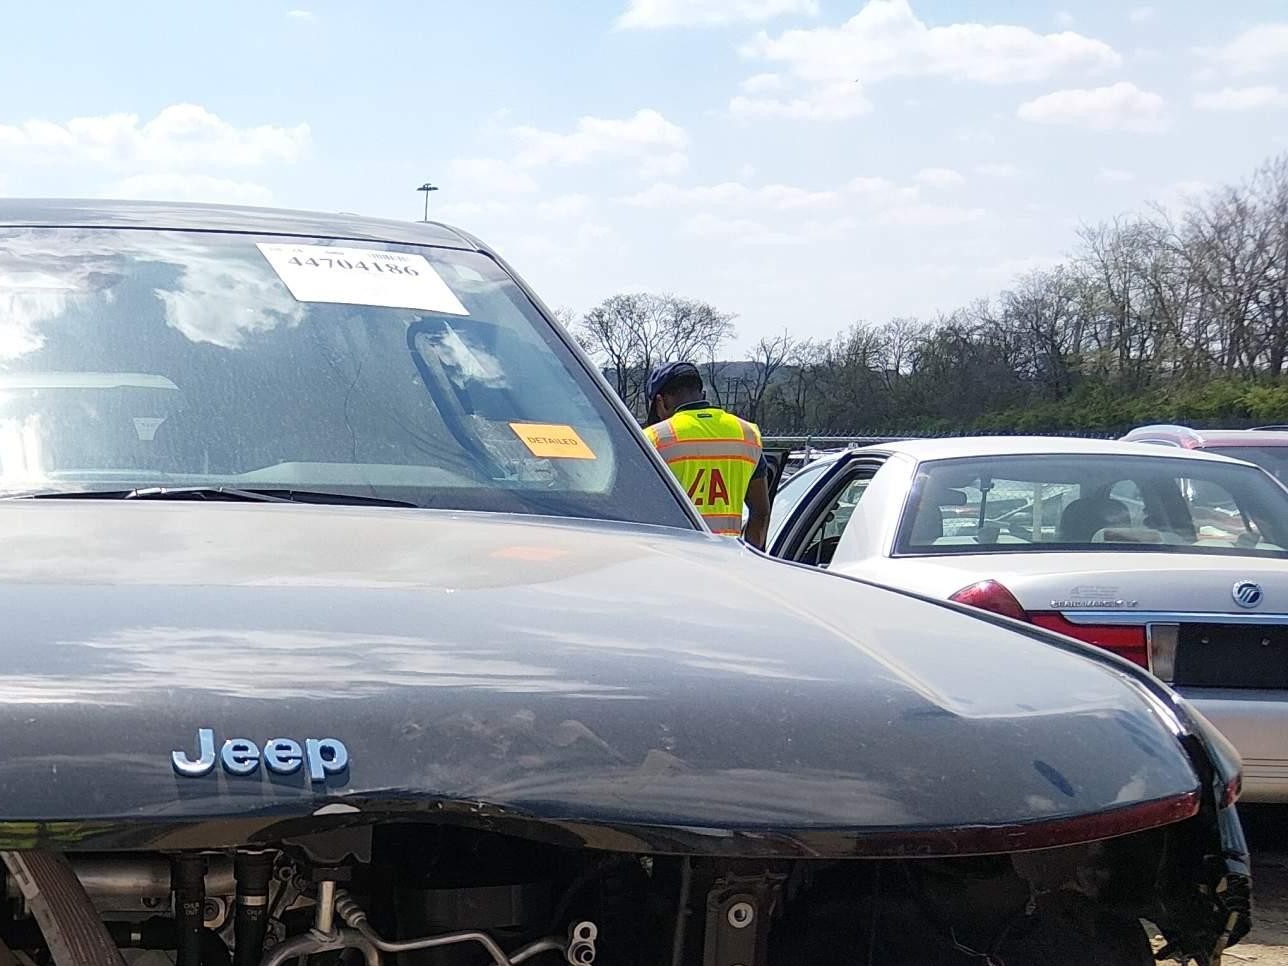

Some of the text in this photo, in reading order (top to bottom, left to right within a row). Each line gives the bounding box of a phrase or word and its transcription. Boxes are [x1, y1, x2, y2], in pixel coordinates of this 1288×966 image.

[287, 256, 419, 276] 44704186
[526, 437, 578, 446] DETAILED
[172, 728, 349, 782] Jeep
